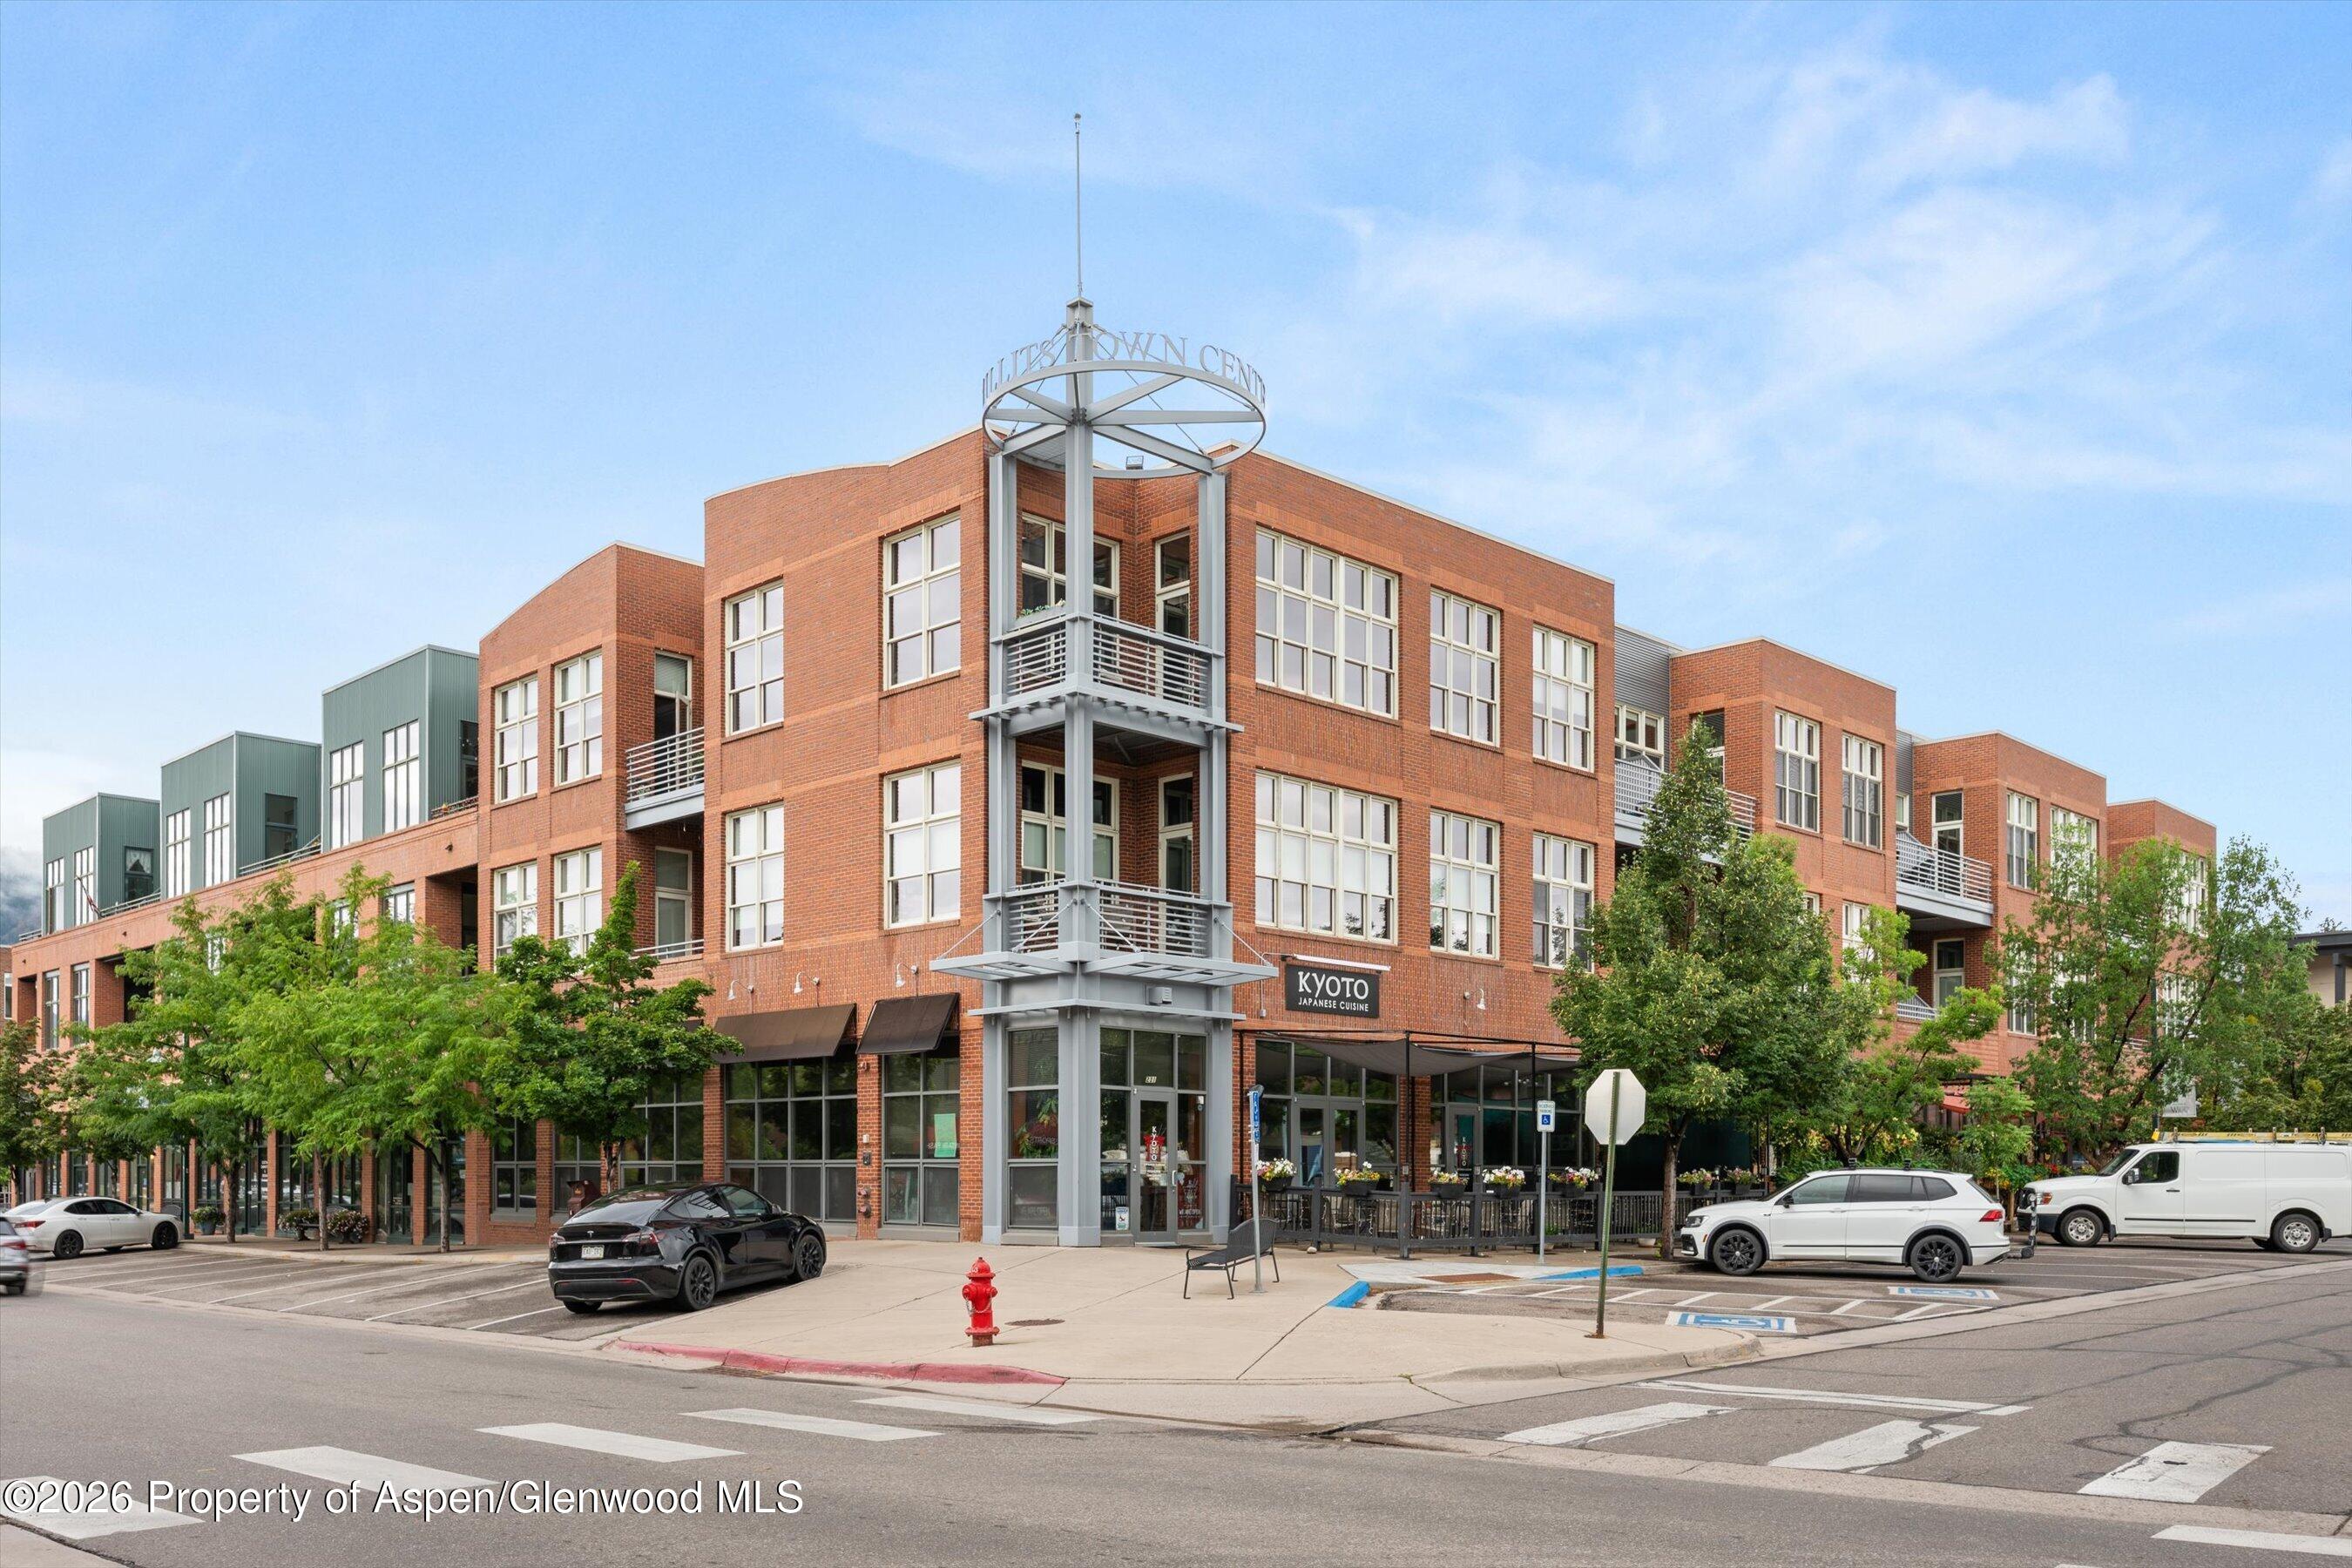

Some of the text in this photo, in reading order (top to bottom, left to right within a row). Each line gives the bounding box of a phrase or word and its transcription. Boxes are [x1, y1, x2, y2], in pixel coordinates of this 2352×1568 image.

[983, 339, 1057, 407] ILLITS
[1069, 331, 1188, 366] TOWN
[1298, 971, 1369, 1000] KYOTO
[1298, 997, 1369, 1012] JAPANESE CUISINE
